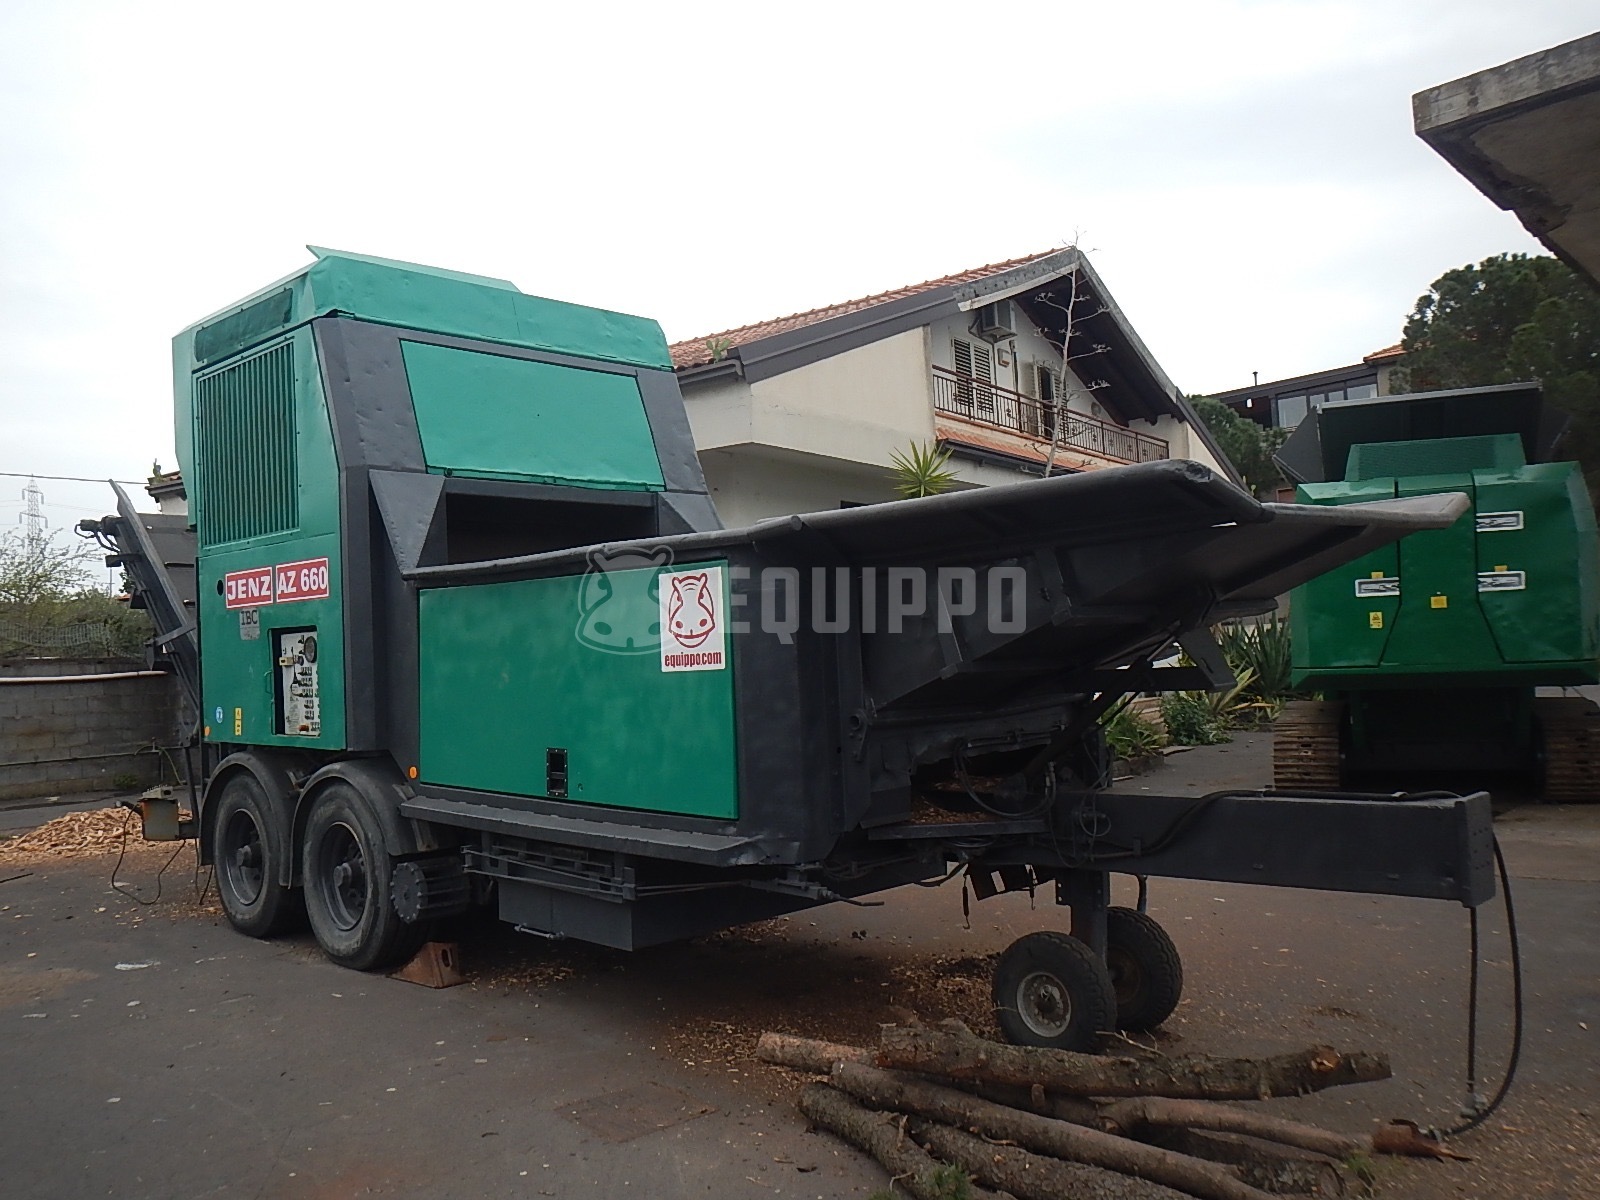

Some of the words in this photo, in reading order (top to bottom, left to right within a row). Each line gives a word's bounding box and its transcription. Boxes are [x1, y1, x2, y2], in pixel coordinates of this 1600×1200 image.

[227, 575, 271, 601] JENZ
[278, 570, 297, 595] AZ
[301, 566, 327, 592] 660
[664, 651, 722, 668] equippo.com
